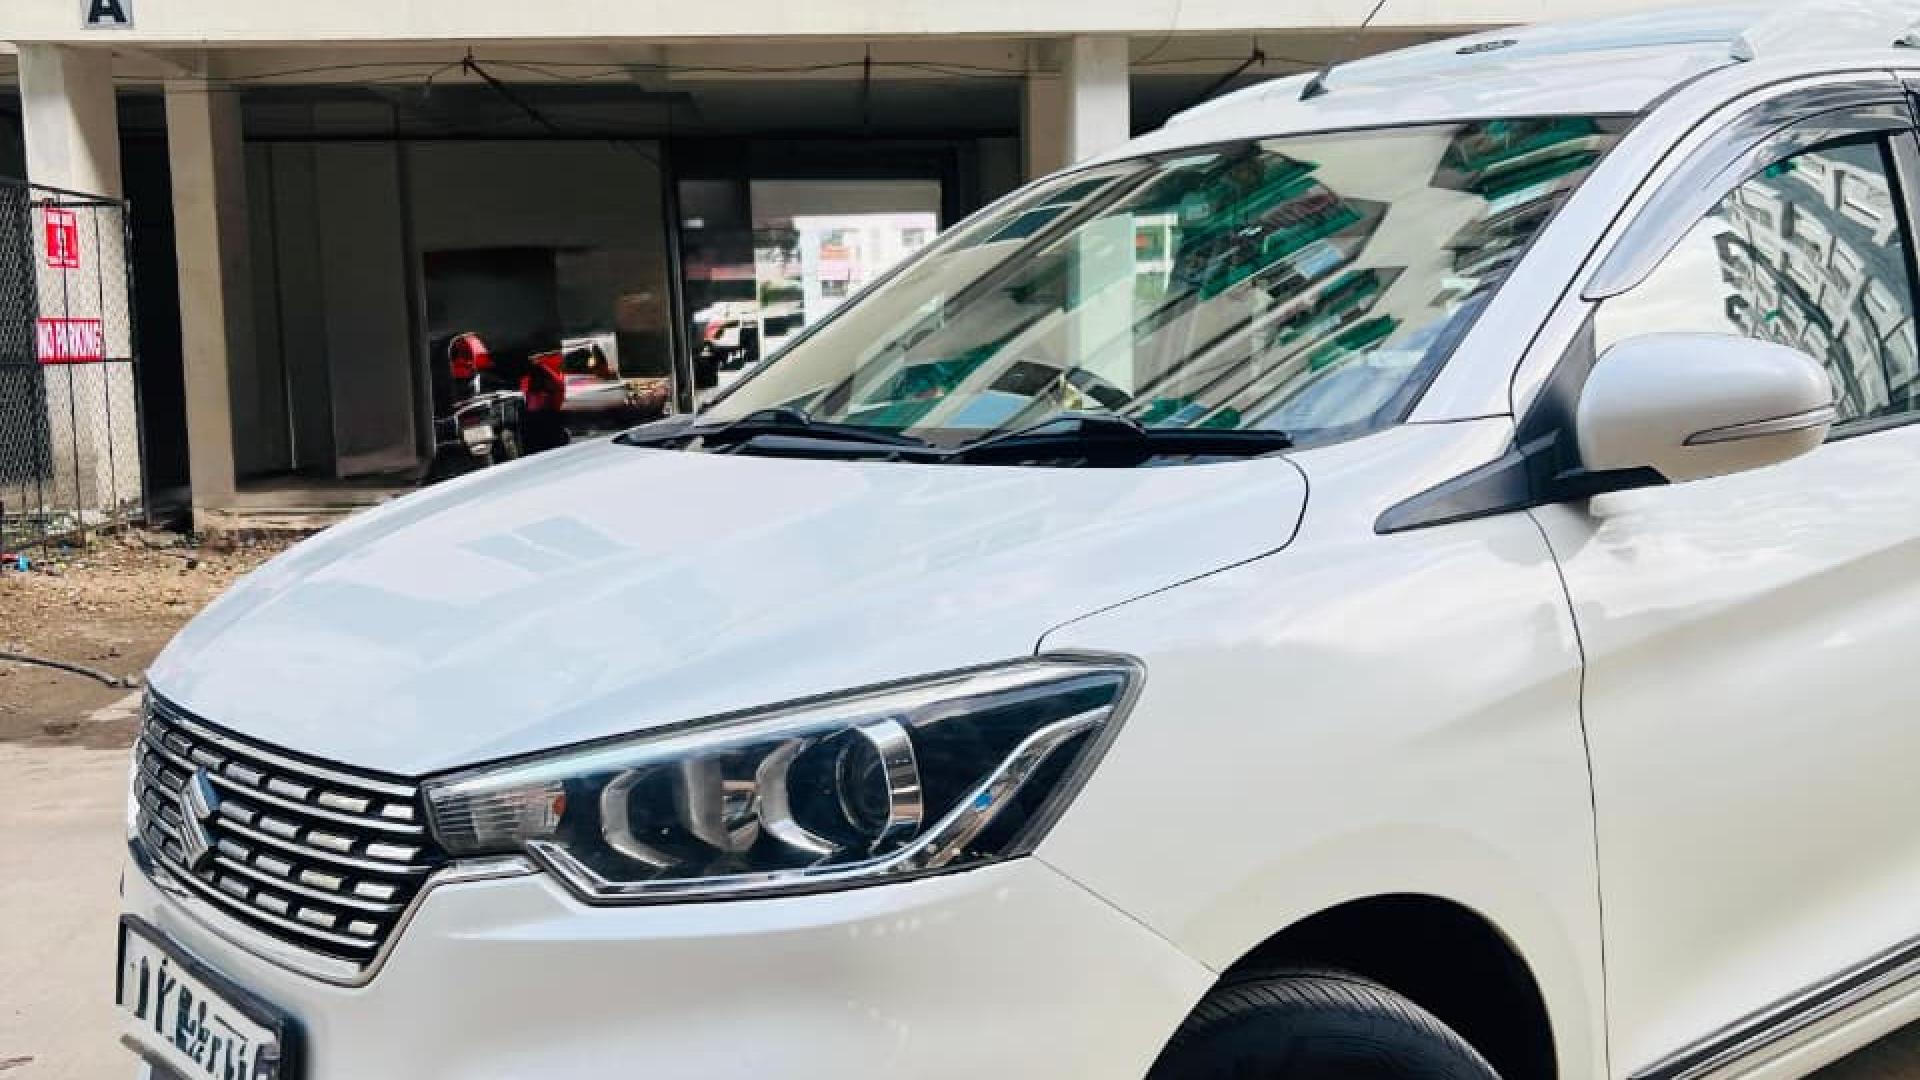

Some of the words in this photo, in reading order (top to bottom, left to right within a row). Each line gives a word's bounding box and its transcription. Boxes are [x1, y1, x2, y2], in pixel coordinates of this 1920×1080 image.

[88, 0, 128, 24] A
[38, 321, 54, 359] NO
[56, 321, 101, 358] PARKING
